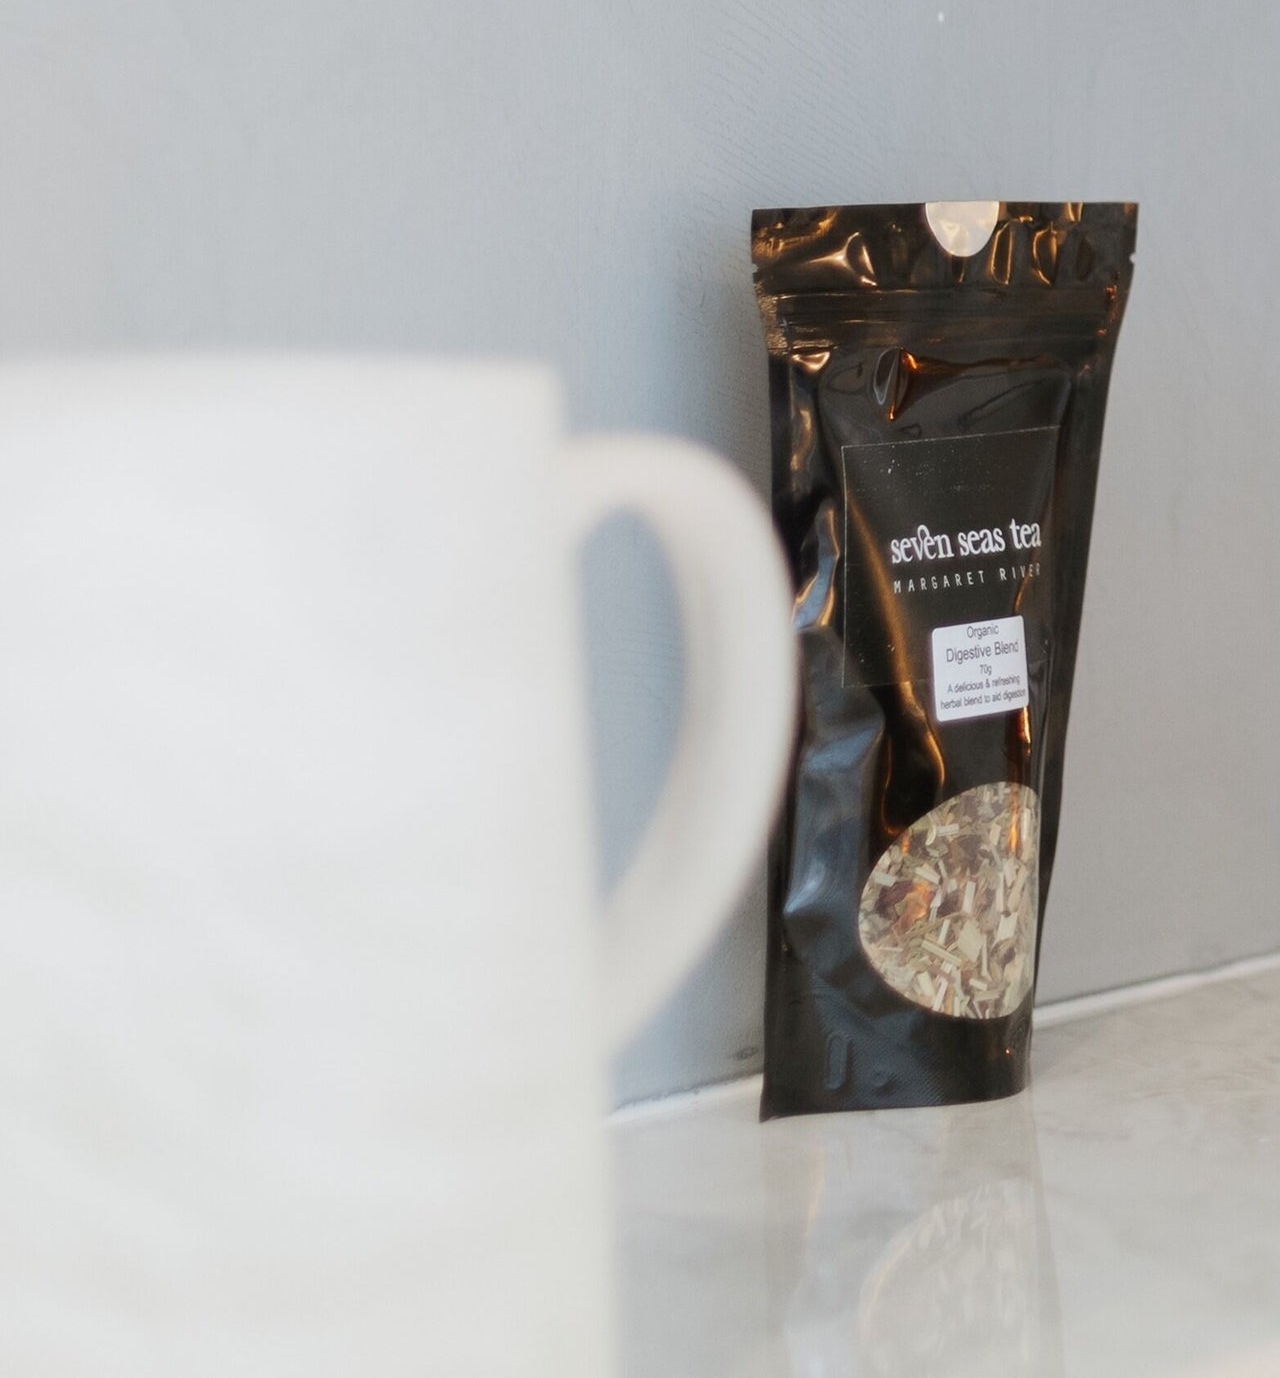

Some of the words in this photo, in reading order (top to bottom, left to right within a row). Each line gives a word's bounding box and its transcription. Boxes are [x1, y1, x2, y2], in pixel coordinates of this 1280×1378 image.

[891, 524, 954, 563] seven
[958, 528, 1006, 556] seas
[1009, 518, 1042, 549] tea
[893, 571, 985, 594] MARGARET
[1000, 563, 1040, 581] RIVER
[967, 623, 999, 639] Organic
[946, 645, 991, 664] Digestive
[994, 640, 1019, 655] Blend
[980, 664, 992, 675] 70g
[947, 684, 953, 693] A
[955, 681, 983, 693] delicious
[992, 675, 1020, 686] refreshing
[941, 699, 962, 710] herbal
[964, 695, 983, 706] blend
[985, 694, 990, 702] to
[992, 691, 1001, 701] aid
